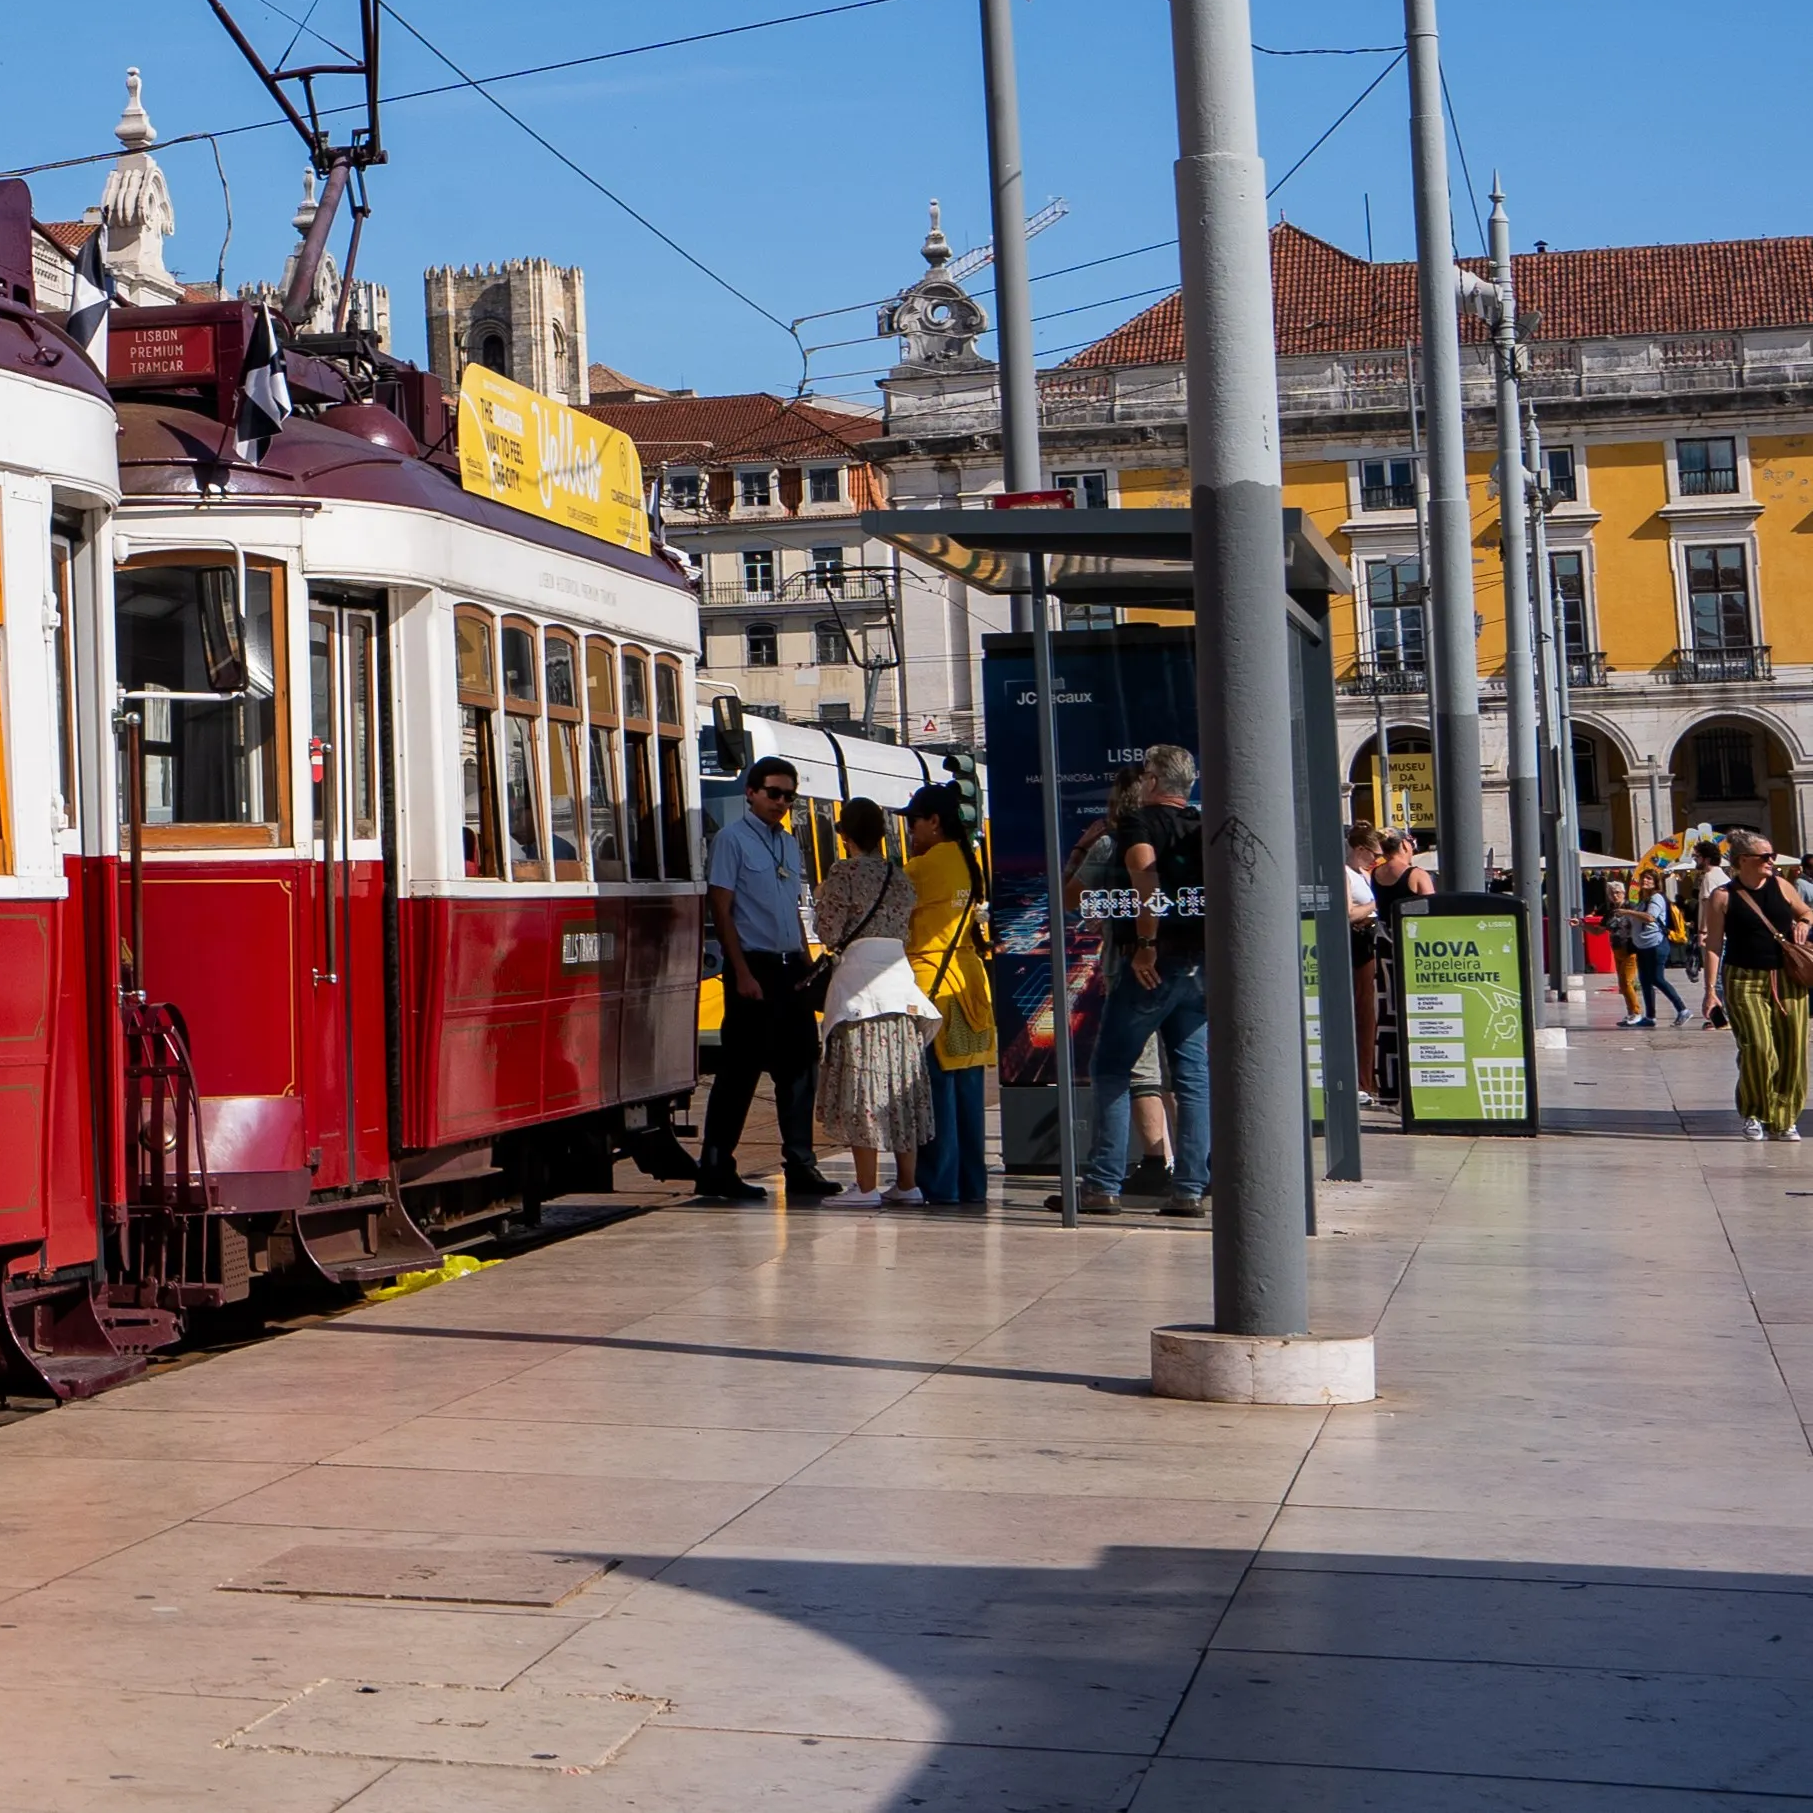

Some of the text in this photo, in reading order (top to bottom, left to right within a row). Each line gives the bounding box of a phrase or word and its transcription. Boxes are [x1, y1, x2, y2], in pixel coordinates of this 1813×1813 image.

[135, 329, 178, 343] LISBON
[130, 344, 184, 359] PREMIUM
[130, 360, 184, 374] TRAMCAR
[1017, 691, 1093, 706] JCecaux
[1108, 748, 1147, 763] LISB
[1389, 763, 1426, 772] MUSEU
[1399, 774, 1415, 782] DA
[1389, 783, 1432, 793] ERVEJA
[1396, 803, 1423, 812] BER
[1414, 941, 1480, 958] NOVA
[1414, 957, 1481, 971] Papeleira
[1415, 971, 1501, 983] INTELIGENTE
